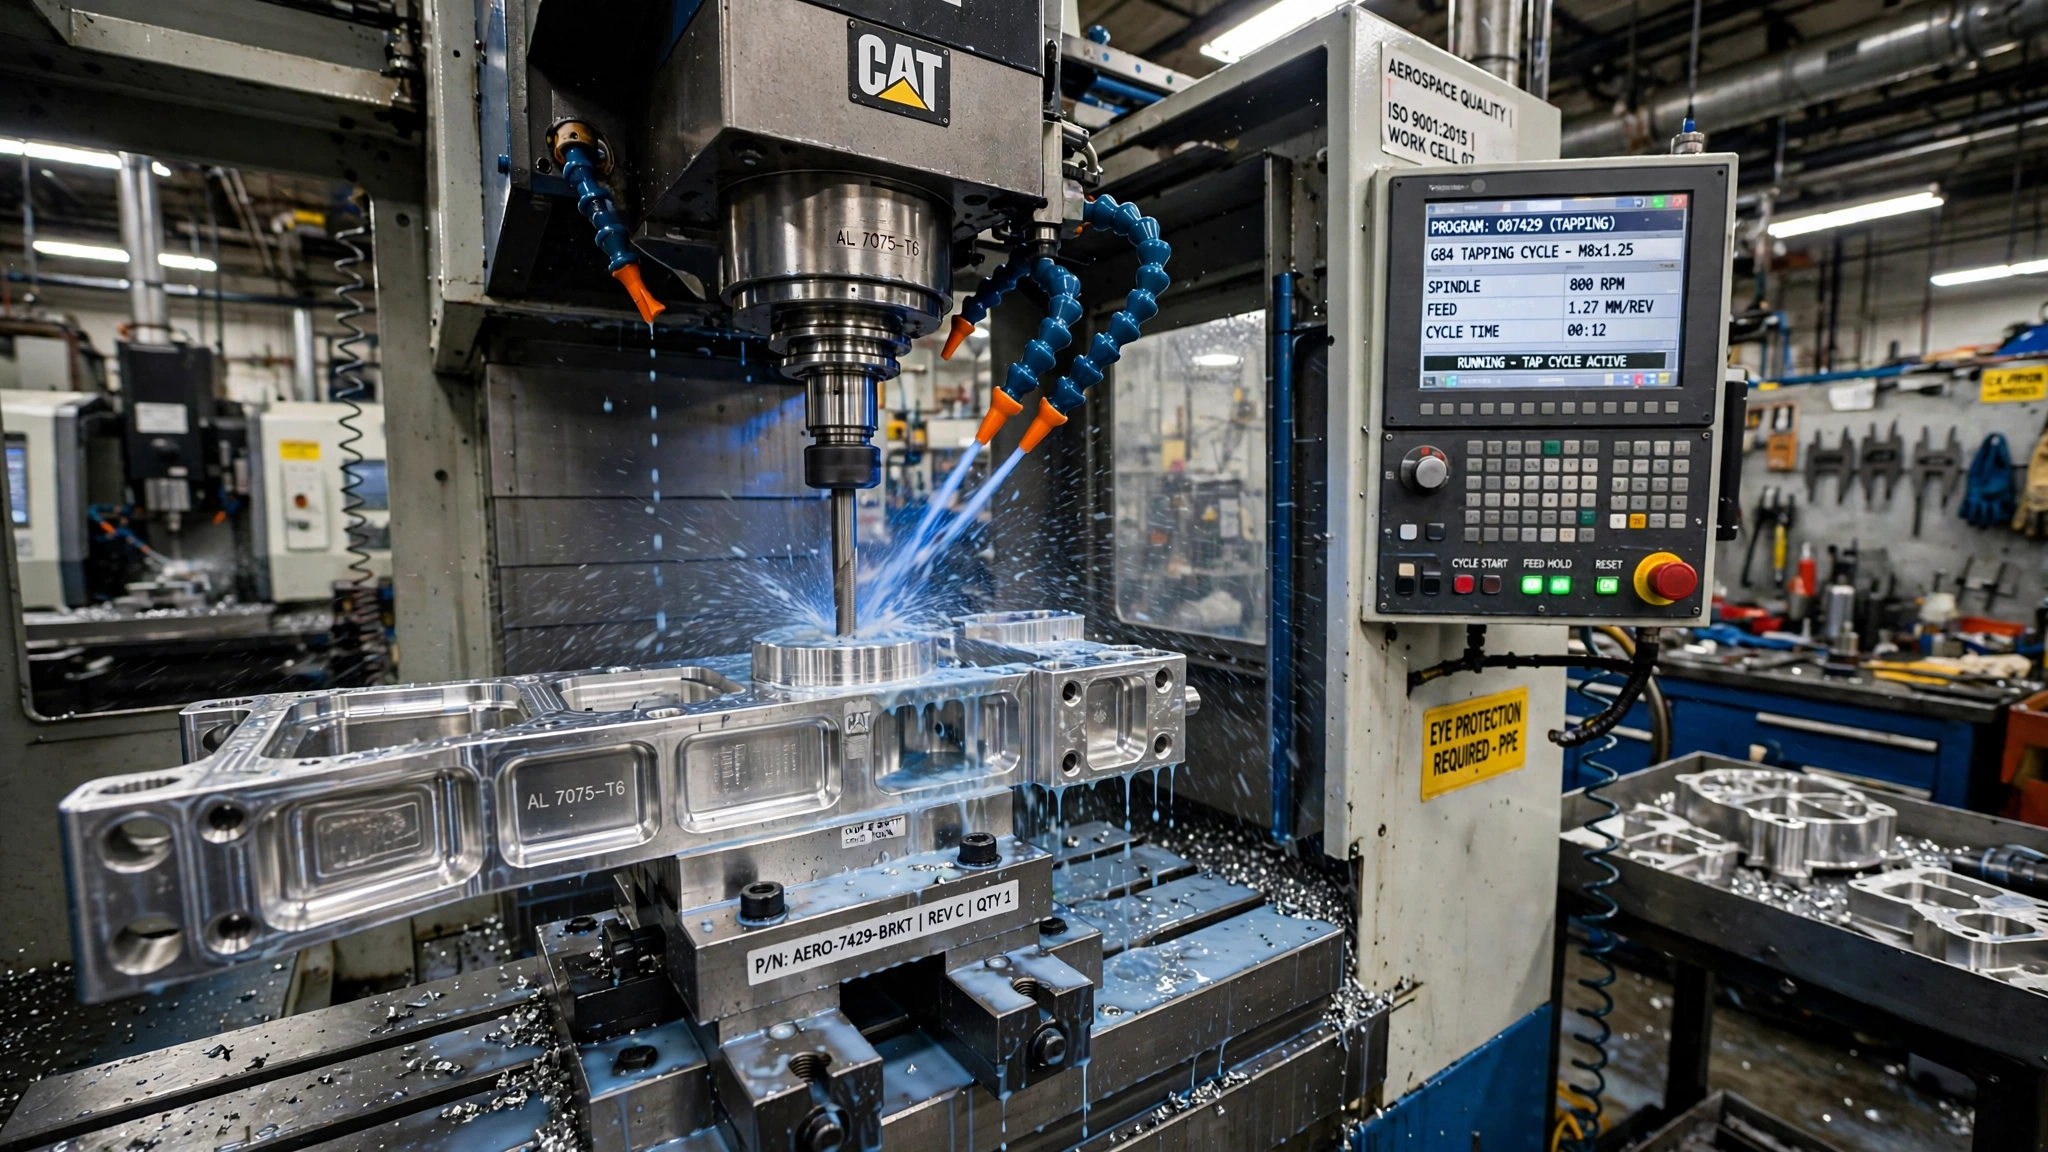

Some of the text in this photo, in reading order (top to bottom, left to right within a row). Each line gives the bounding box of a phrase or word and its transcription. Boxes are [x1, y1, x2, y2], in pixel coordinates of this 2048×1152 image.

[858, 34, 943, 112] CAT
[1388, 58, 1458, 102] AEROSPACE
[1460, 89, 1506, 122] QUALITY
[1388, 101, 1409, 123] ISO
[1411, 111, 1468, 146] 9001:2015
[1388, 124, 1427, 154] WORK
[1430, 141, 1459, 165] CELL
[1431, 219, 1490, 234] PROGRAM:
[1550, 215, 1616, 233] (TAPPING)
[836, 230, 920, 256] AL 7075-T6
[1430, 248, 1454, 261] G84
[1462, 246, 1515, 260] TAPPING
[1520, 245, 1559, 258] CYCLE
[1578, 243, 1634, 257] M8x1.25
[1428, 280, 1481, 293] SPINDLE
[1569, 277, 1625, 291] 800 RPM
[1427, 303, 1457, 316] FEED
[1568, 300, 1654, 314] 1.27 MM/REV
[1426, 325, 1500, 338] CYCLE TIME
[1567, 323, 1606, 336] 00:12
[1457, 356, 1506, 368] RUNNING
[1523, 356, 1543, 368] TAP
[1548, 355, 1582, 368] CYCLE
[1586, 355, 1627, 367] ACTIVE
[1452, 558, 1509, 568] CYCLE START
[1523, 558, 1572, 568] FEED HOLD
[1595, 559, 1623, 569] RESET
[1430, 700, 1522, 746] EYE PROTECTION
[1433, 739, 1489, 776] REQUIRED
[1499, 729, 1518, 756] PPE
[527, 780, 626, 810] AL 7075-T6
[755, 952, 789, 974] P/N:
[792, 917, 913, 964] AERO-7429-BRKT
[928, 907, 954, 926] REV
[955, 903, 964, 917] C
[976, 892, 1002, 912] QTY
[1005, 890, 1011, 904] 1
